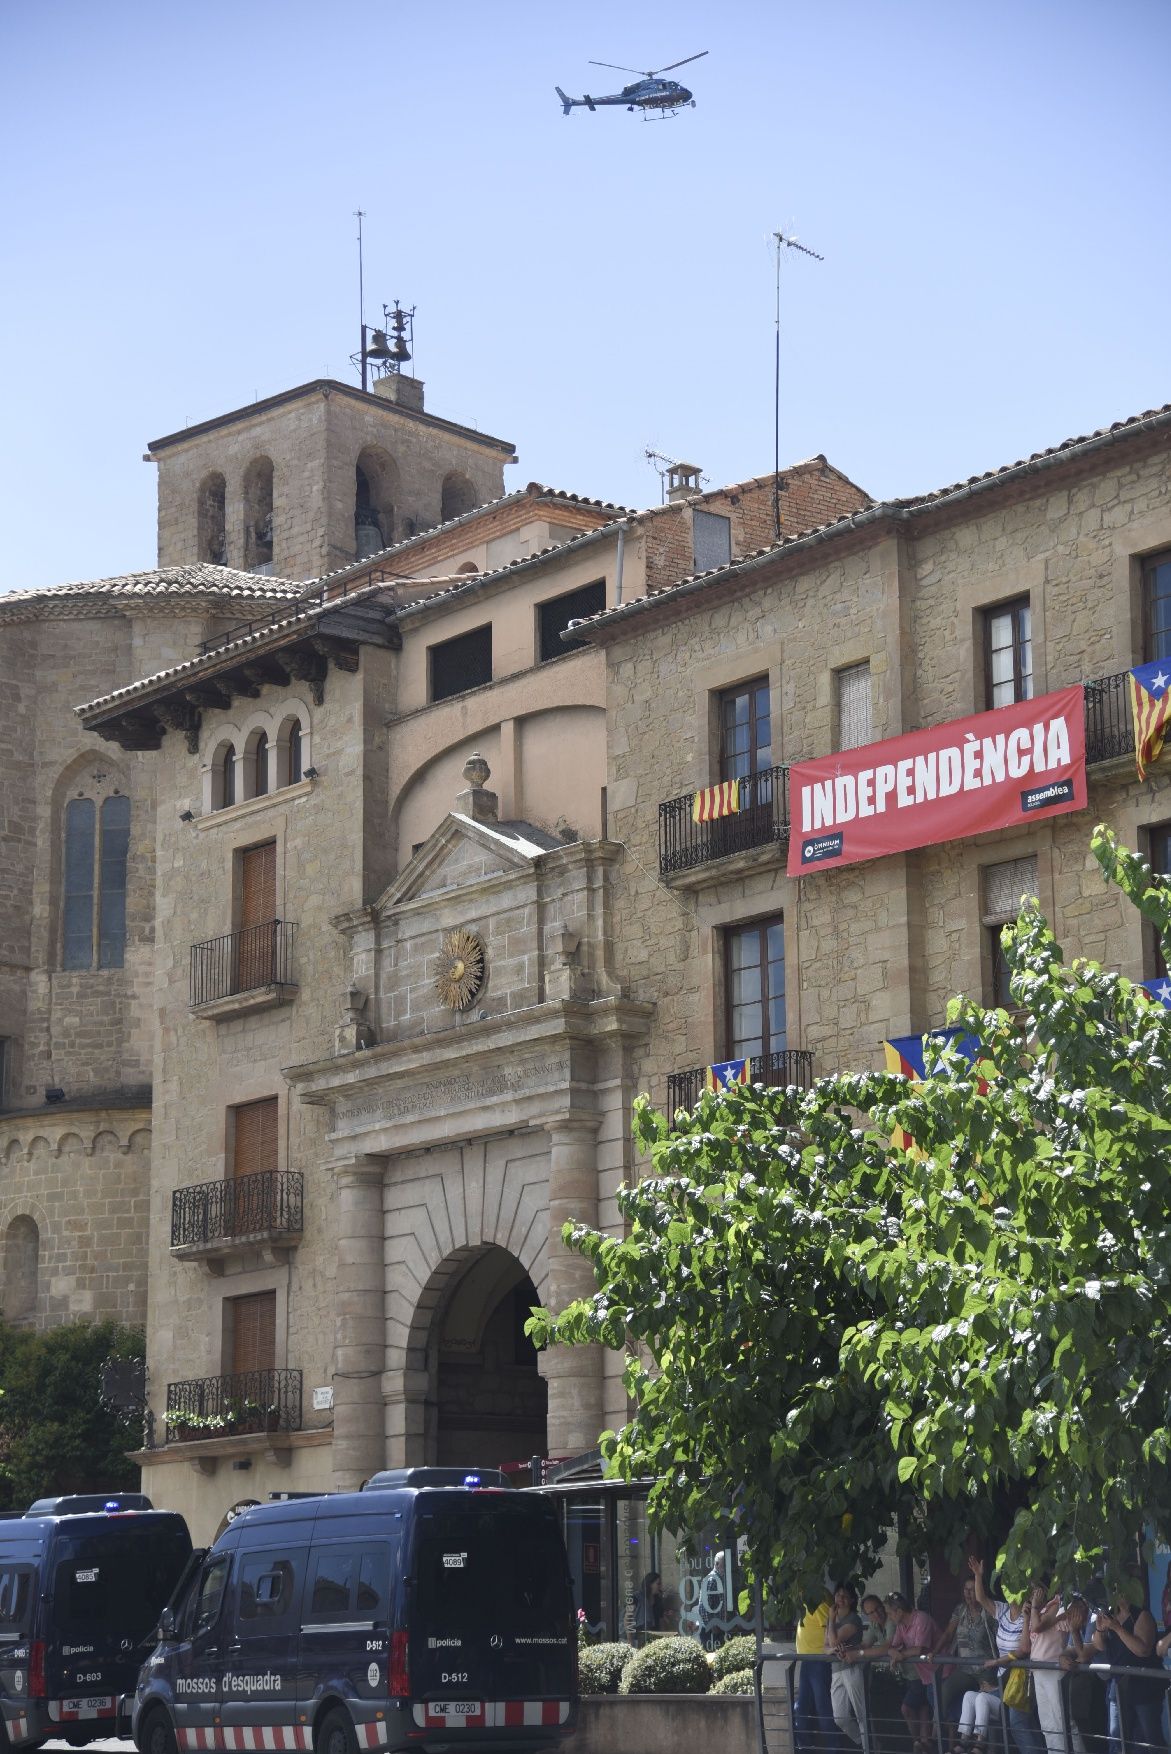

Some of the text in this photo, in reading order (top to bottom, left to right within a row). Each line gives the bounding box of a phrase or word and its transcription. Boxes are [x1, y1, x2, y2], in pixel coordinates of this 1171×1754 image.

[801, 716, 1071, 832] INDEPENDÈNCIA
[1027, 785, 1069, 803] assemblea
[678, 1549, 734, 1638] gel
[366, 1640, 383, 1651] D-512
[514, 1636, 568, 1644] www.mossos.cat
[76, 1672, 102, 1683] D-603
[176, 1671, 281, 1695] mossos d'esquadra
[441, 1672, 468, 1683] D-512
[68, 1698, 107, 1710] CME 0236
[434, 1703, 476, 1714] CME 0230
